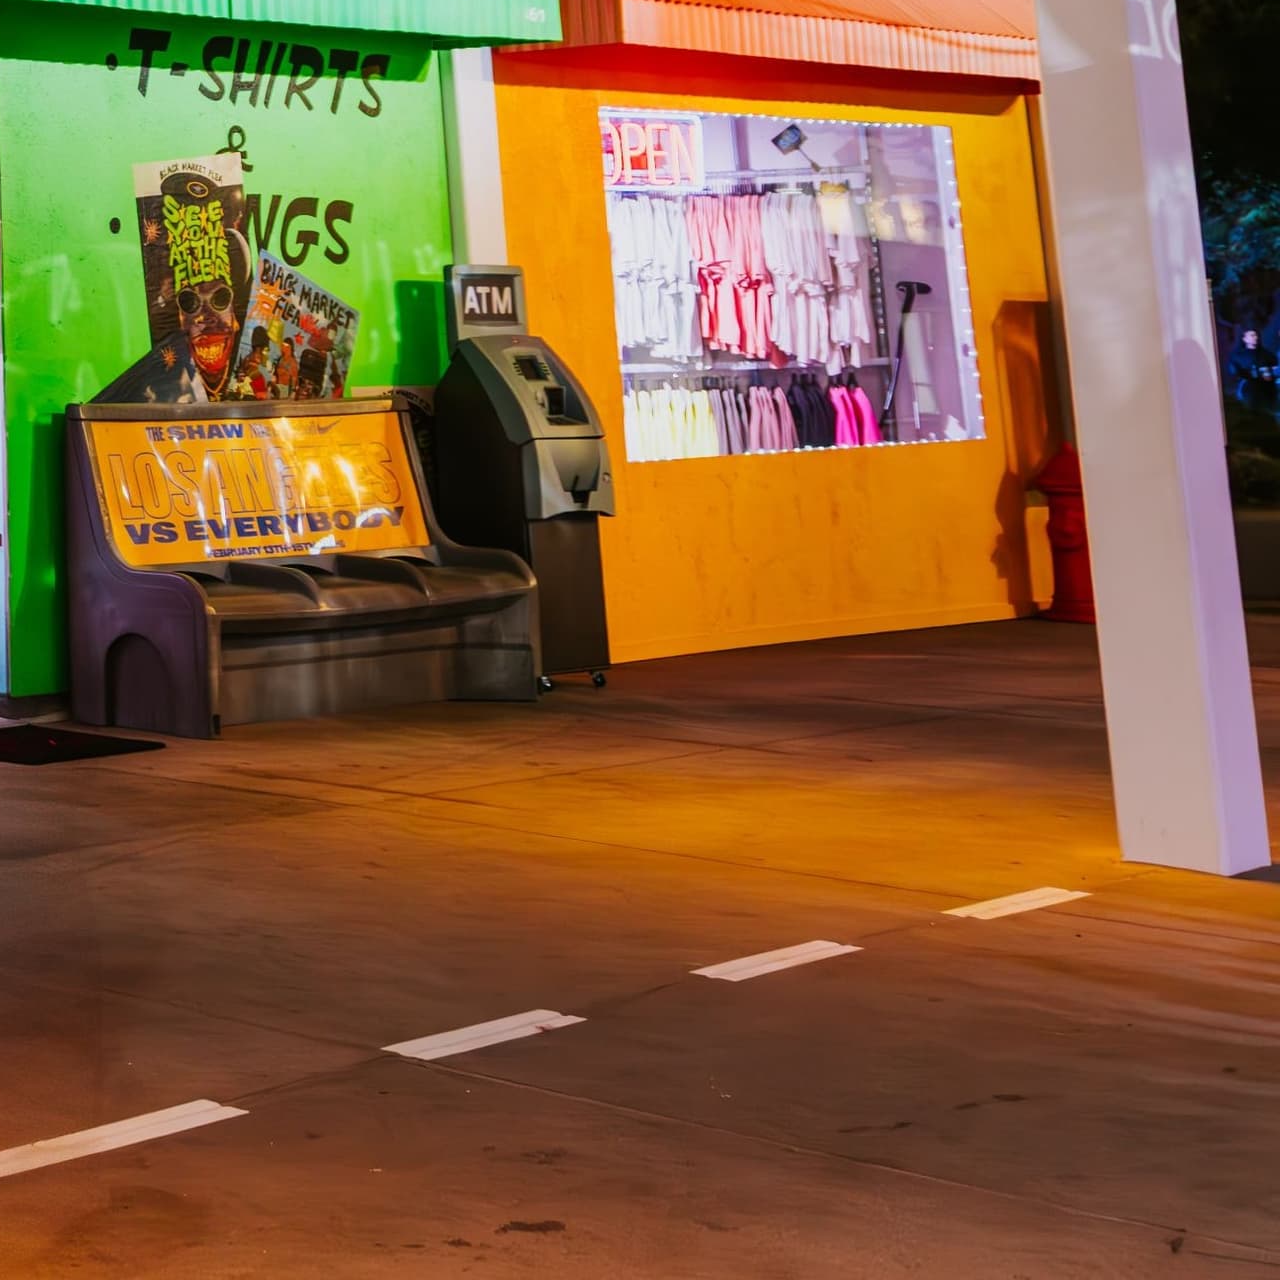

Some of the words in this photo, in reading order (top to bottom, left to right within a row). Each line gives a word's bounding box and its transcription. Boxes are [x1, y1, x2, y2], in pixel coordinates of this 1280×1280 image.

[127, 27, 392, 119] T-SHIRTS
[159, 164, 179, 180] BLACK
[181, 163, 207, 176] MARKET
[207, 169, 224, 184] FLEA
[162, 194, 224, 227] SEE
[164, 219, 224, 246] YOU
[246, 192, 354, 266] NGS
[168, 243, 190, 267] AT
[189, 236, 230, 265] THE
[174, 257, 233, 295] FLEA
[298, 284, 355, 329] MARKET
[464, 285, 513, 315] ATM
[145, 426, 164, 442] THE
[167, 424, 244, 441] SHAW
[108, 451, 197, 520] LOS
[124, 523, 186, 545] VS
[186, 506, 405, 541] EVERYBODY
